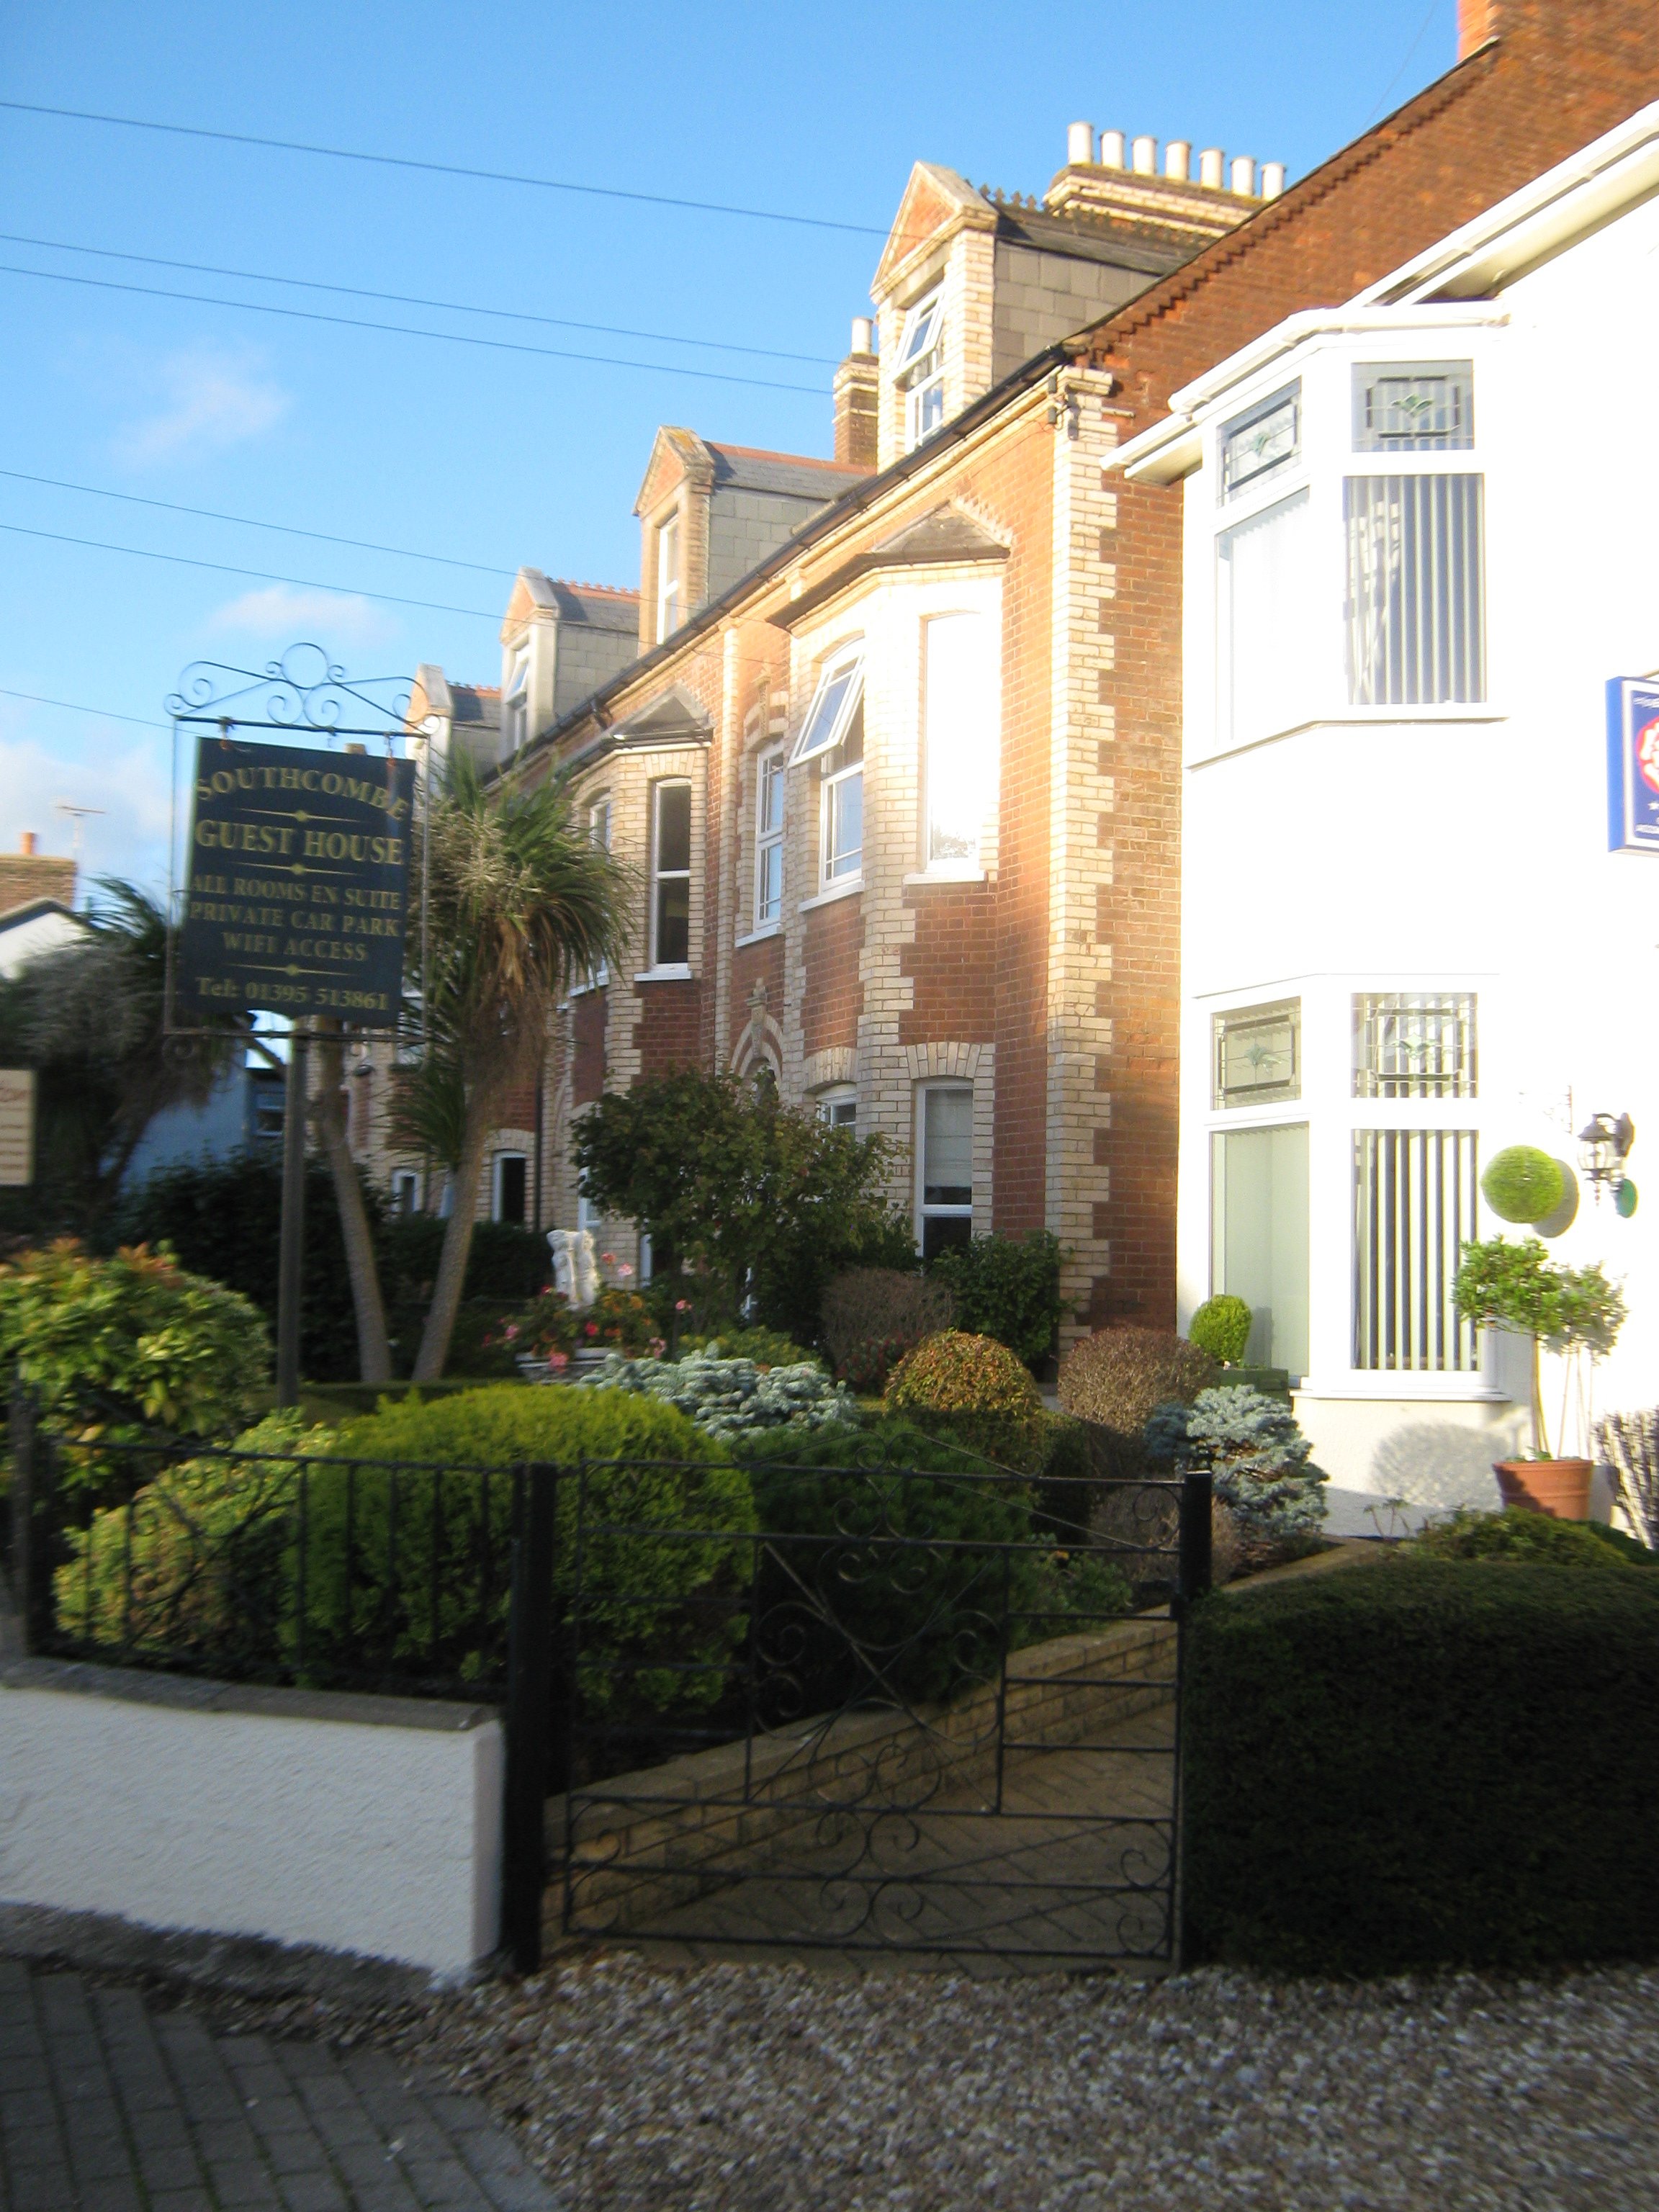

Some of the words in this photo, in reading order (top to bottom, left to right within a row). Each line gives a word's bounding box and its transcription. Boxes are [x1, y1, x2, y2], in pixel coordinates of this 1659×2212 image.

[197, 766, 410, 822] SOUTHCOMBE
[194, 819, 293, 855] GUEST
[304, 831, 403, 864] HOUSE
[192, 874, 225, 894] ALL
[233, 878, 306, 901] ROOMS
[311, 885, 338, 904] EN
[345, 888, 400, 909] SUITE
[189, 902, 284, 927] PRIVATE
[290, 910, 333, 931] CAR
[341, 915, 401, 936] PARK
[221, 932, 278, 953] WIFI
[283, 939, 368, 961] ACCESS
[245, 981, 307, 1003] 01395
[315, 988, 389, 1010] 513861
